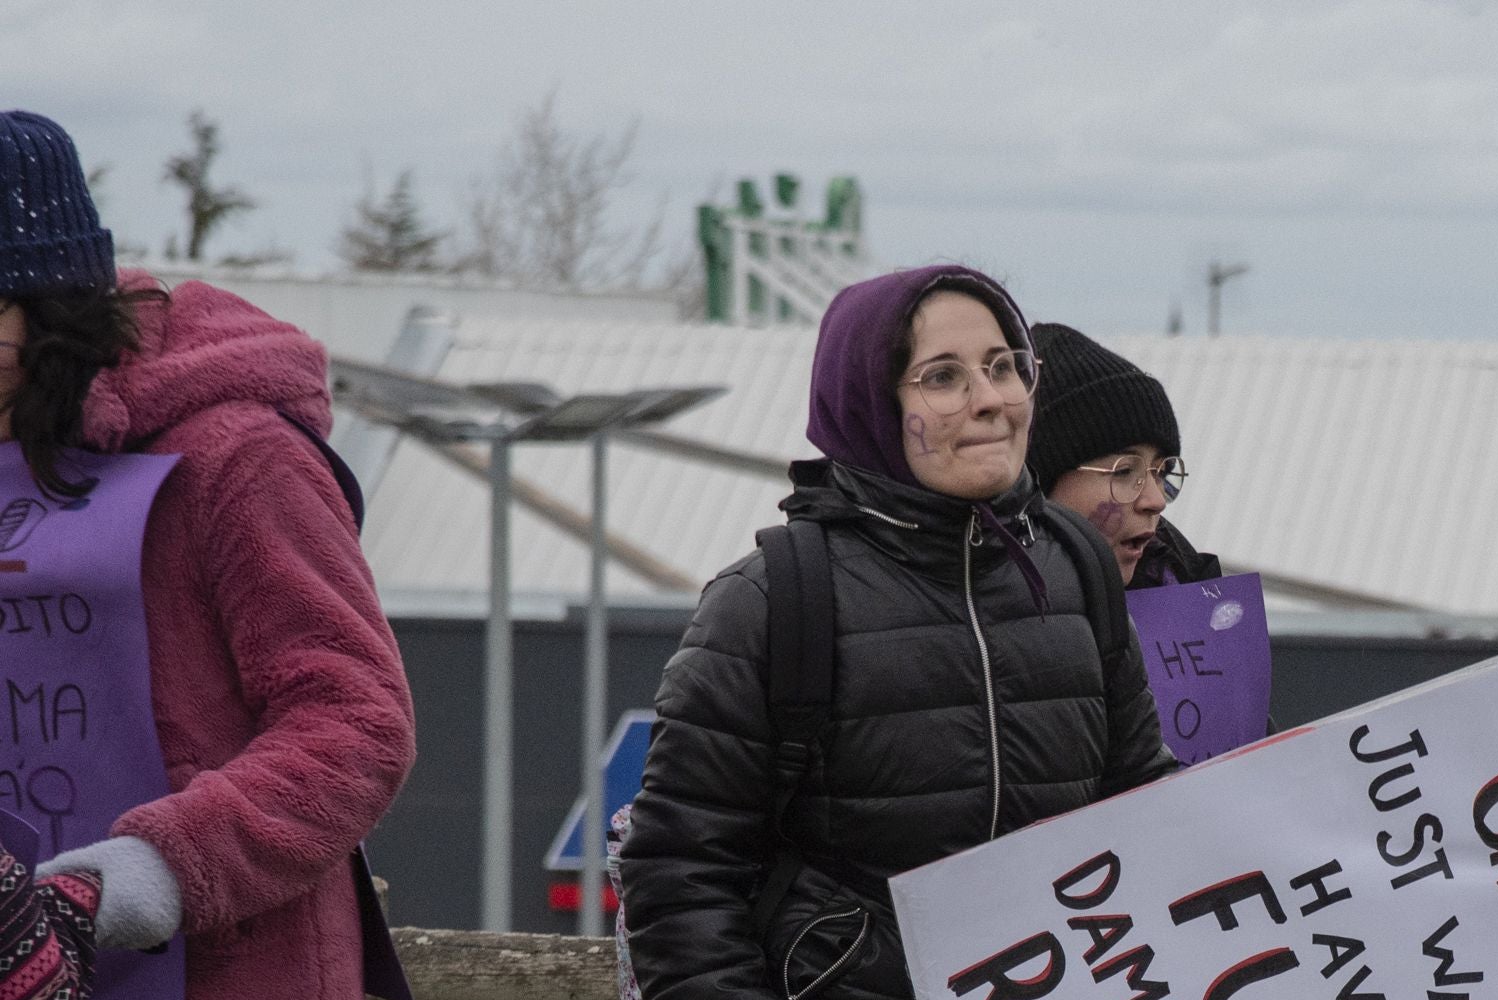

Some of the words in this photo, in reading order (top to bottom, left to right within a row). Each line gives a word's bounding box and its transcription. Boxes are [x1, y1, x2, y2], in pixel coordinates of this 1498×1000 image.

[0, 593, 92, 638] ITO
[1157, 640, 1223, 679] HE
[1349, 725, 1454, 890] JUST
